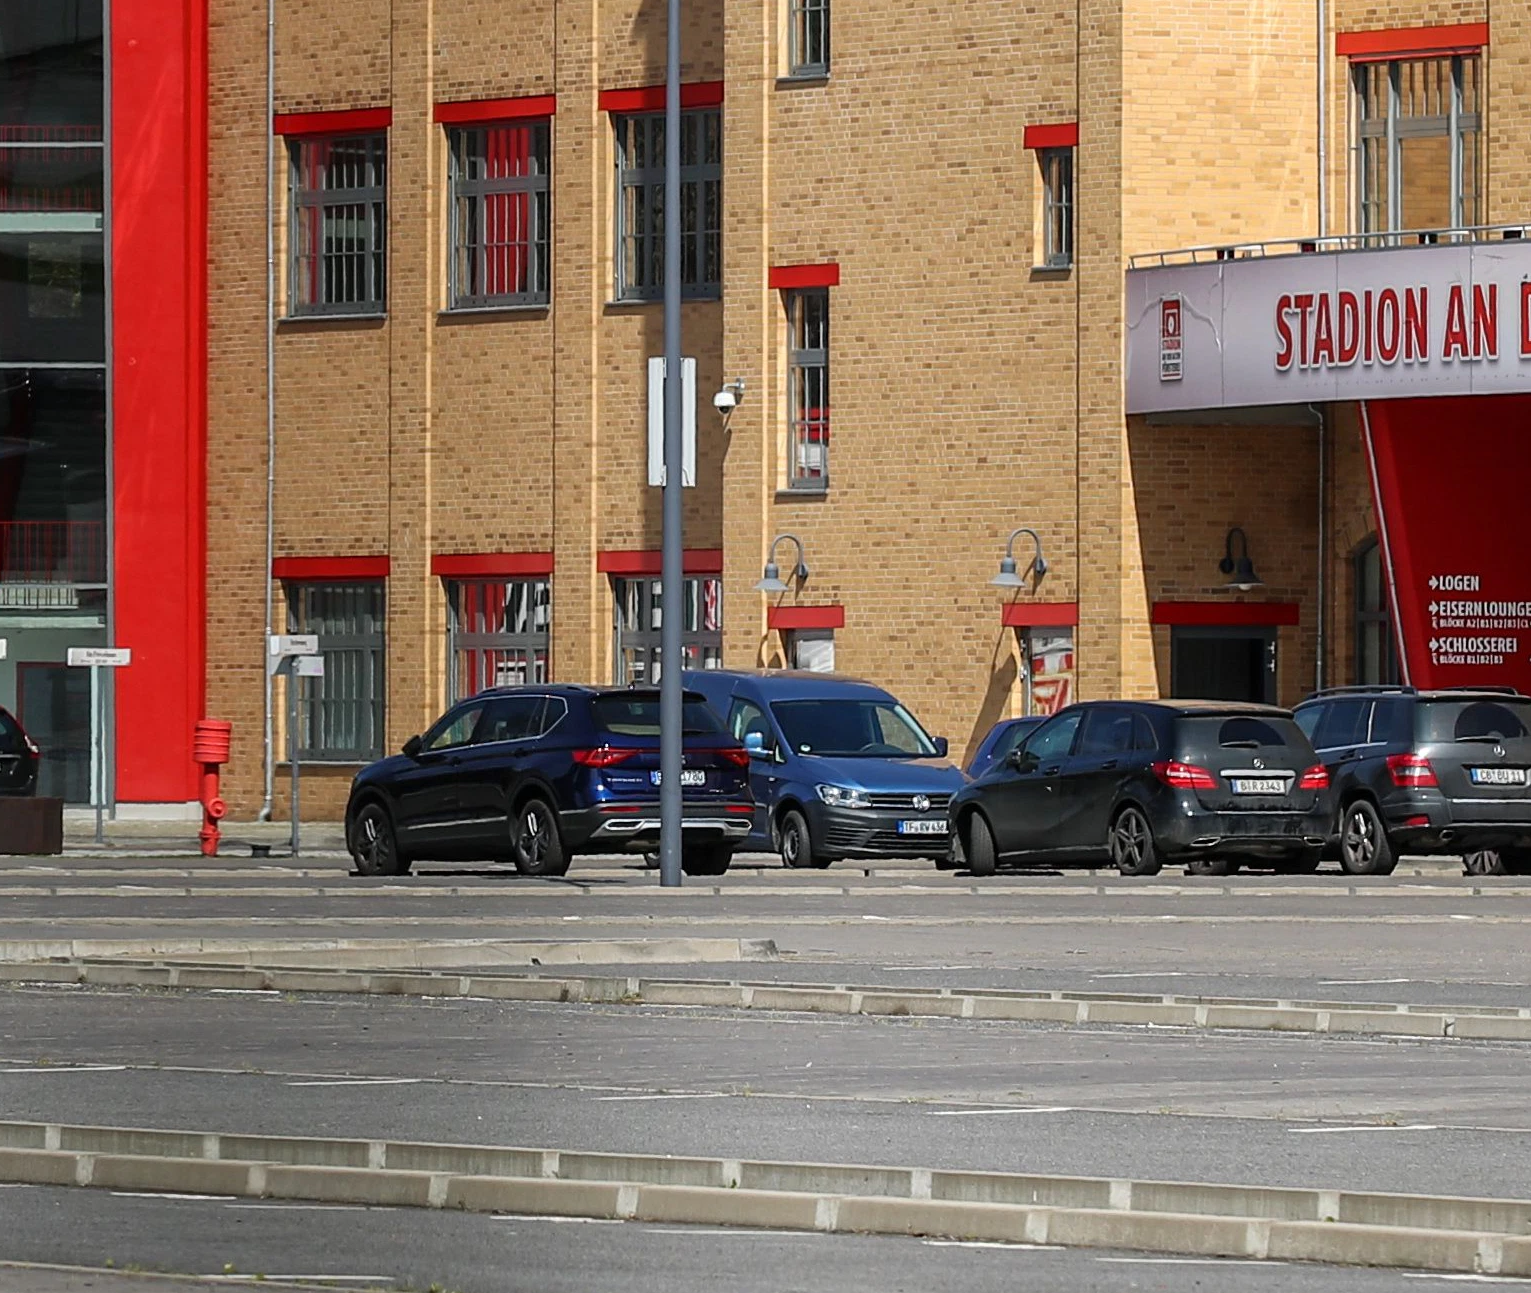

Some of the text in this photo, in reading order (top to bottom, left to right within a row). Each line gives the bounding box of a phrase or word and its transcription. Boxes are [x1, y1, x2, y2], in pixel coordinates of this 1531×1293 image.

[1275, 286, 1428, 368] STADION
[1443, 284, 1498, 360] AN
[1439, 575, 1479, 591] LOGEN
[1439, 601, 1482, 616] EISERN
[1439, 618, 1465, 628] BLÖCKE
[1439, 637, 1517, 653] SCHLOSSEREI
[1439, 654, 1465, 664] BLÖCKE
